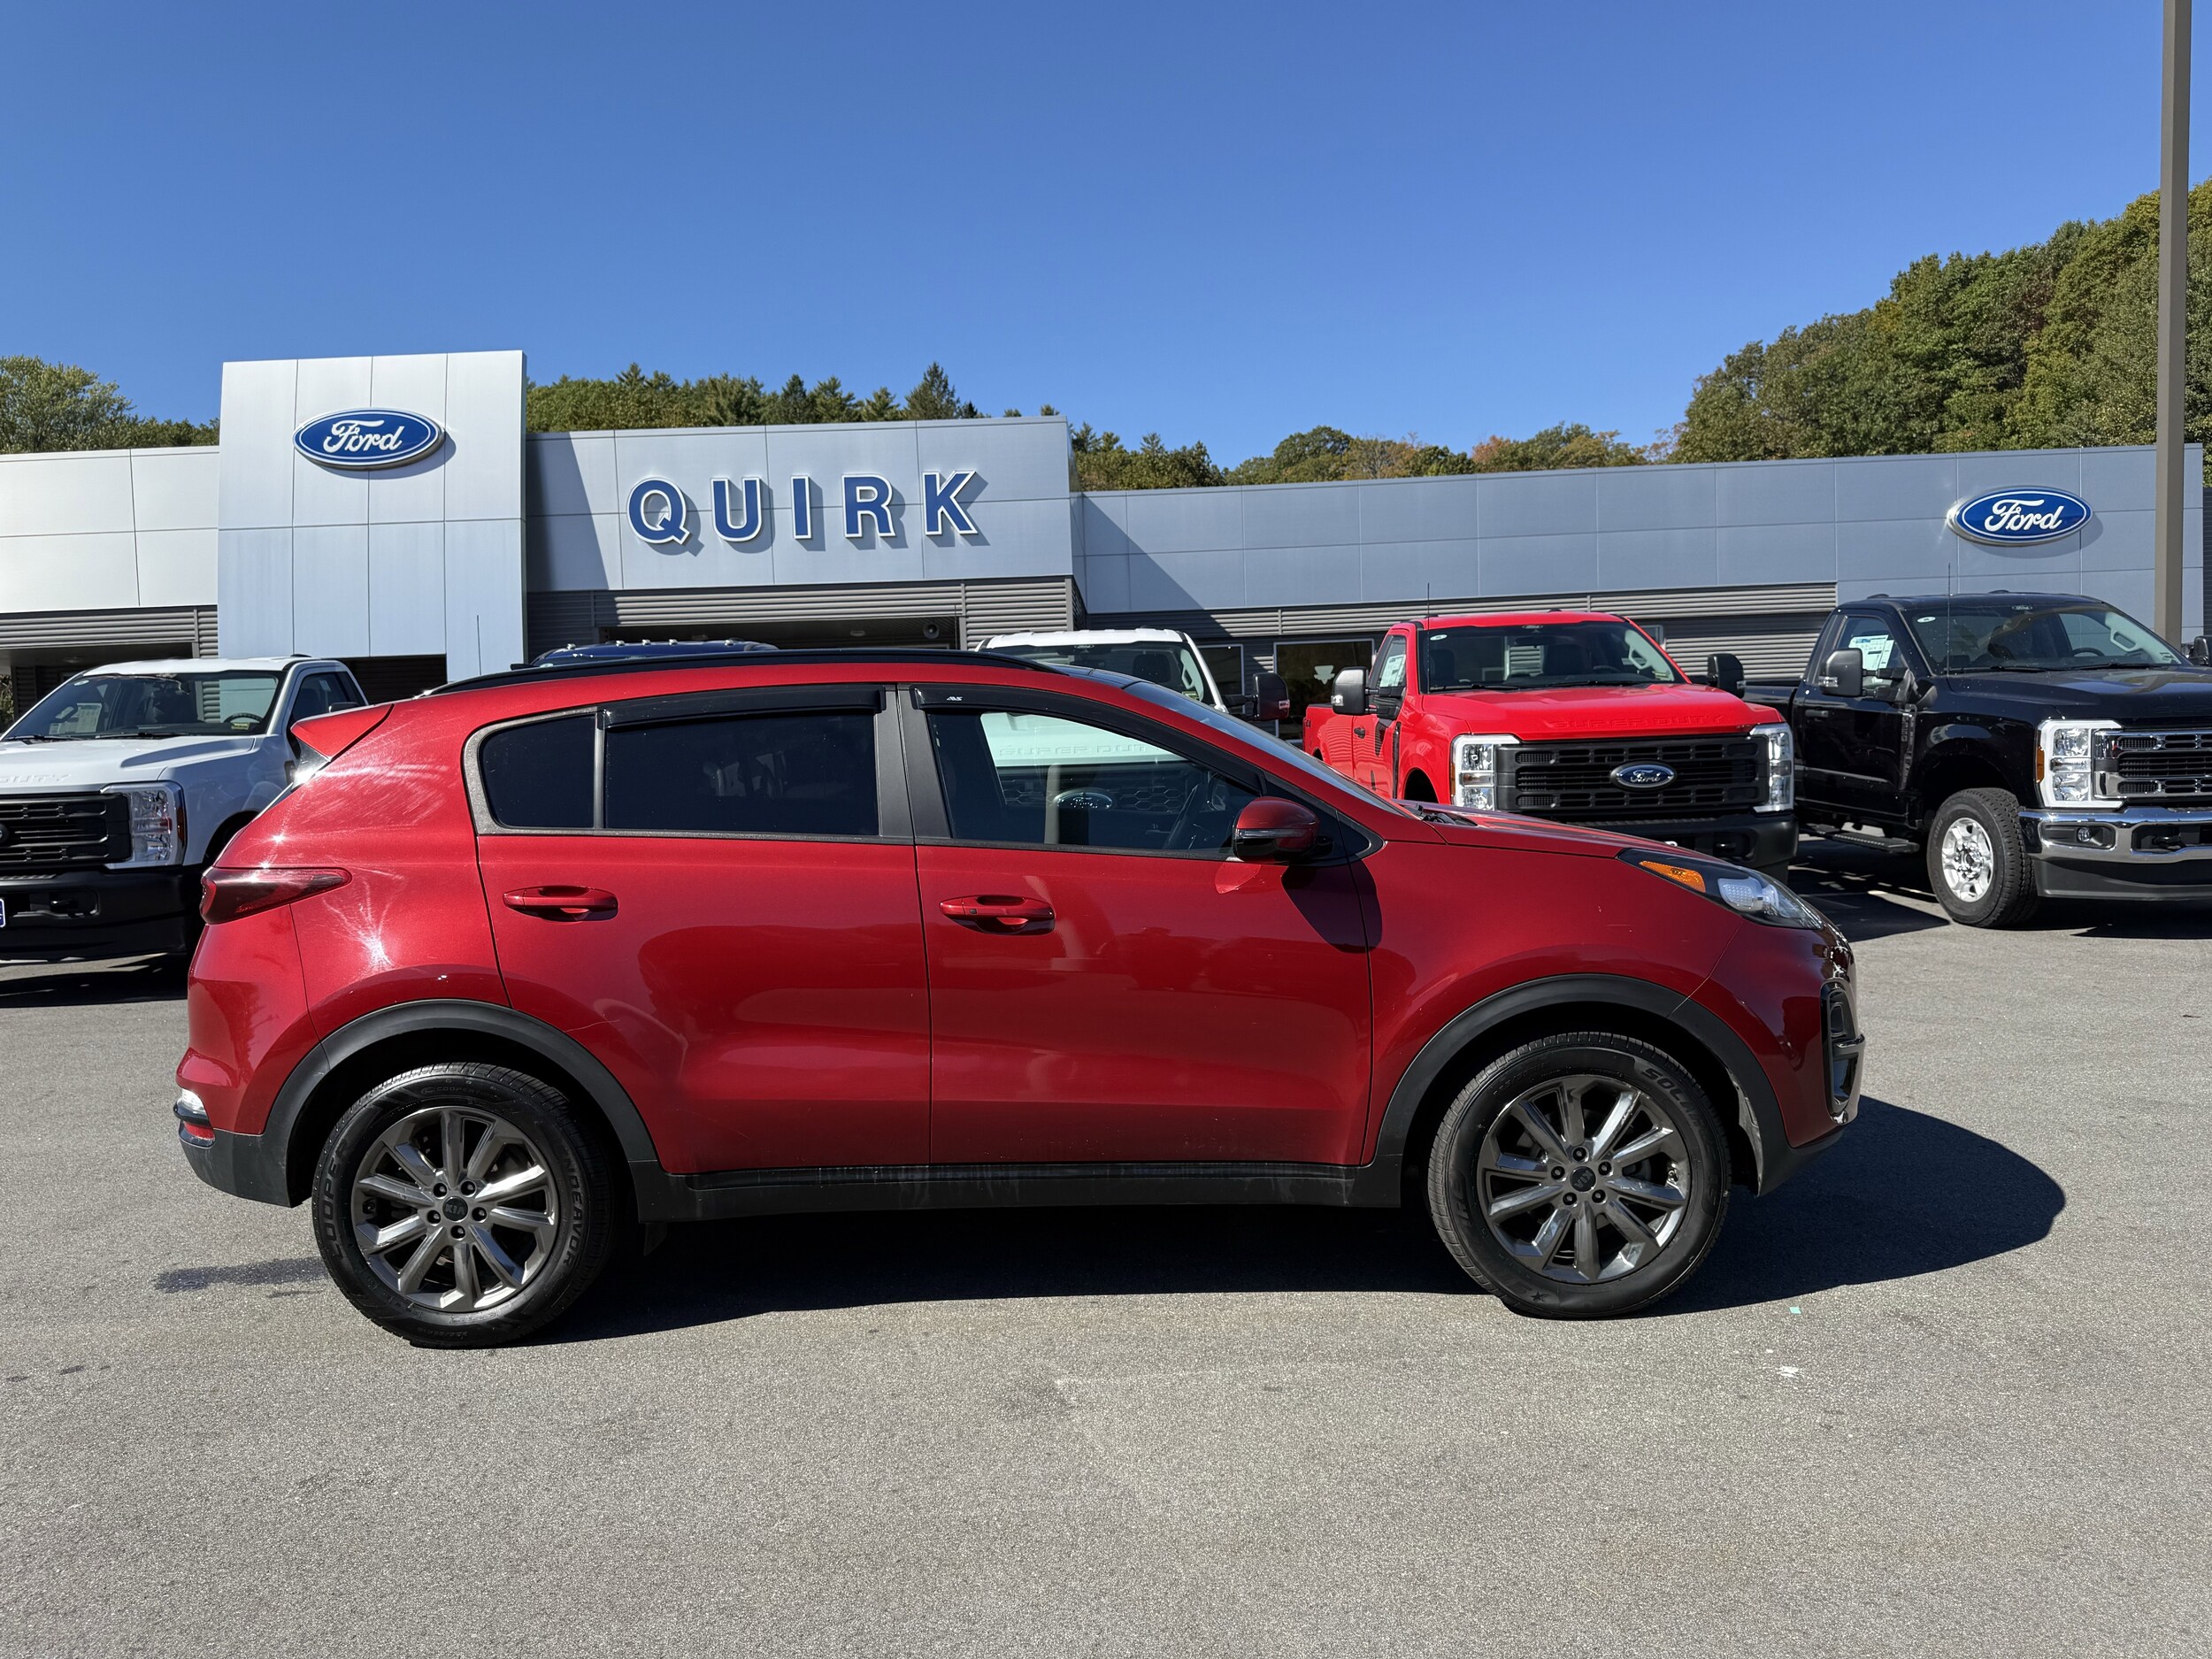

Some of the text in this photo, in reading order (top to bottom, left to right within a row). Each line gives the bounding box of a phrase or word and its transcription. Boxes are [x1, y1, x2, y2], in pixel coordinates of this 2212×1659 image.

[323, 419, 405, 453] Ford
[627, 471, 979, 545] QUIRK
[1985, 499, 2064, 532] Ford
[1550, 714, 1724, 729] SUPER DUTY
[999, 743, 1148, 757] SUPER DUT
[1630, 769, 1662, 783] Ford
[1573, 1169, 1594, 1188] KIA
[323, 1138, 348, 1259] COOPER
[445, 1202, 465, 1217] KIA
